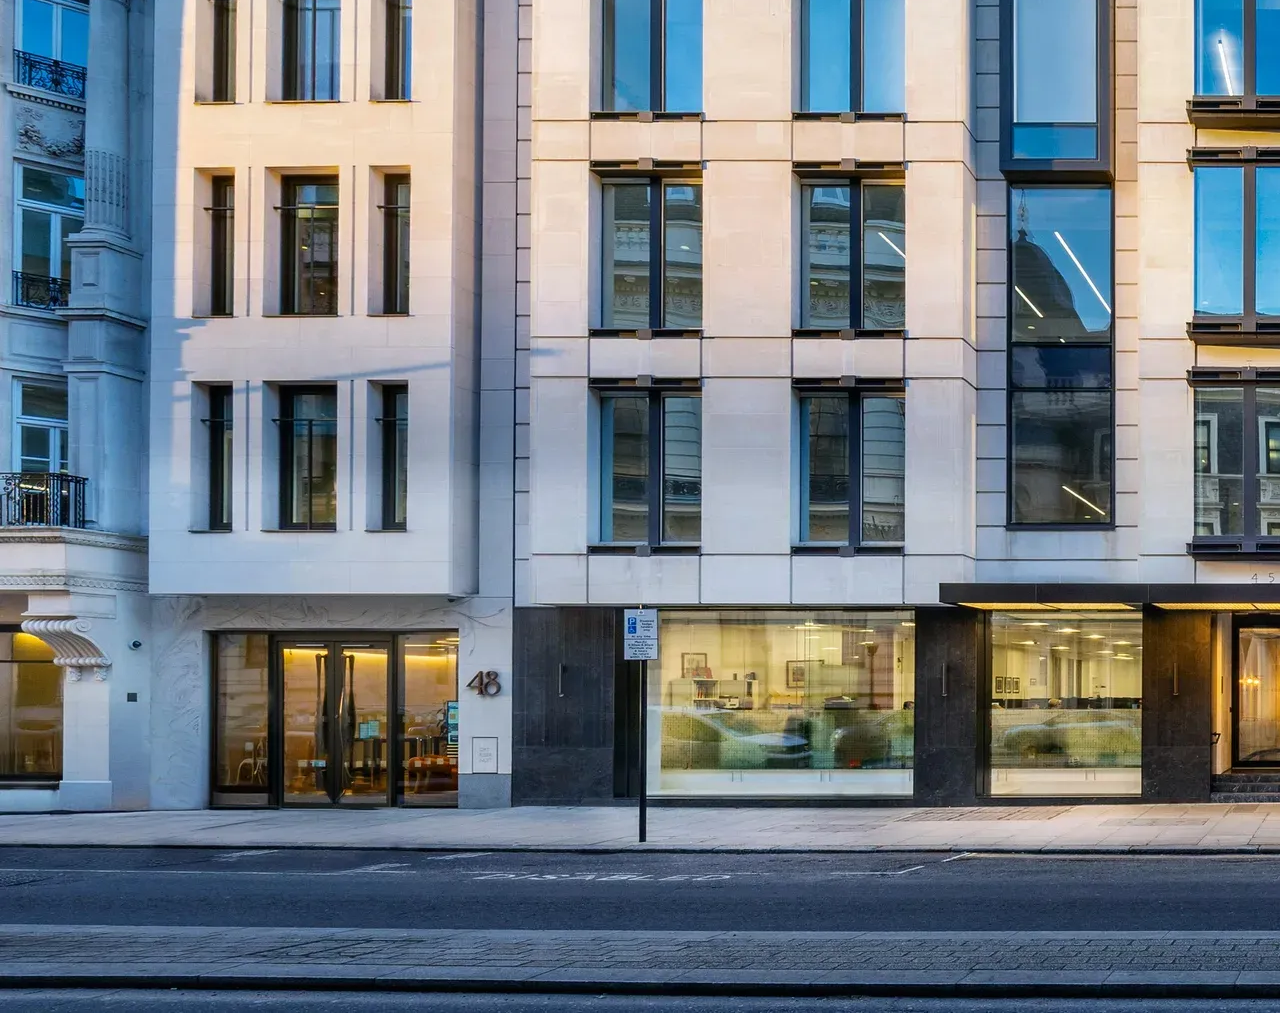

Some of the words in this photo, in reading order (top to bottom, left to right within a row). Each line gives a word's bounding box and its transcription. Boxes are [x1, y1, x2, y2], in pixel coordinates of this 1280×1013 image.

[1251, 572, 1276, 584] 45
[465, 670, 502, 697] 48
[472, 873, 732, 882] DISABLED
